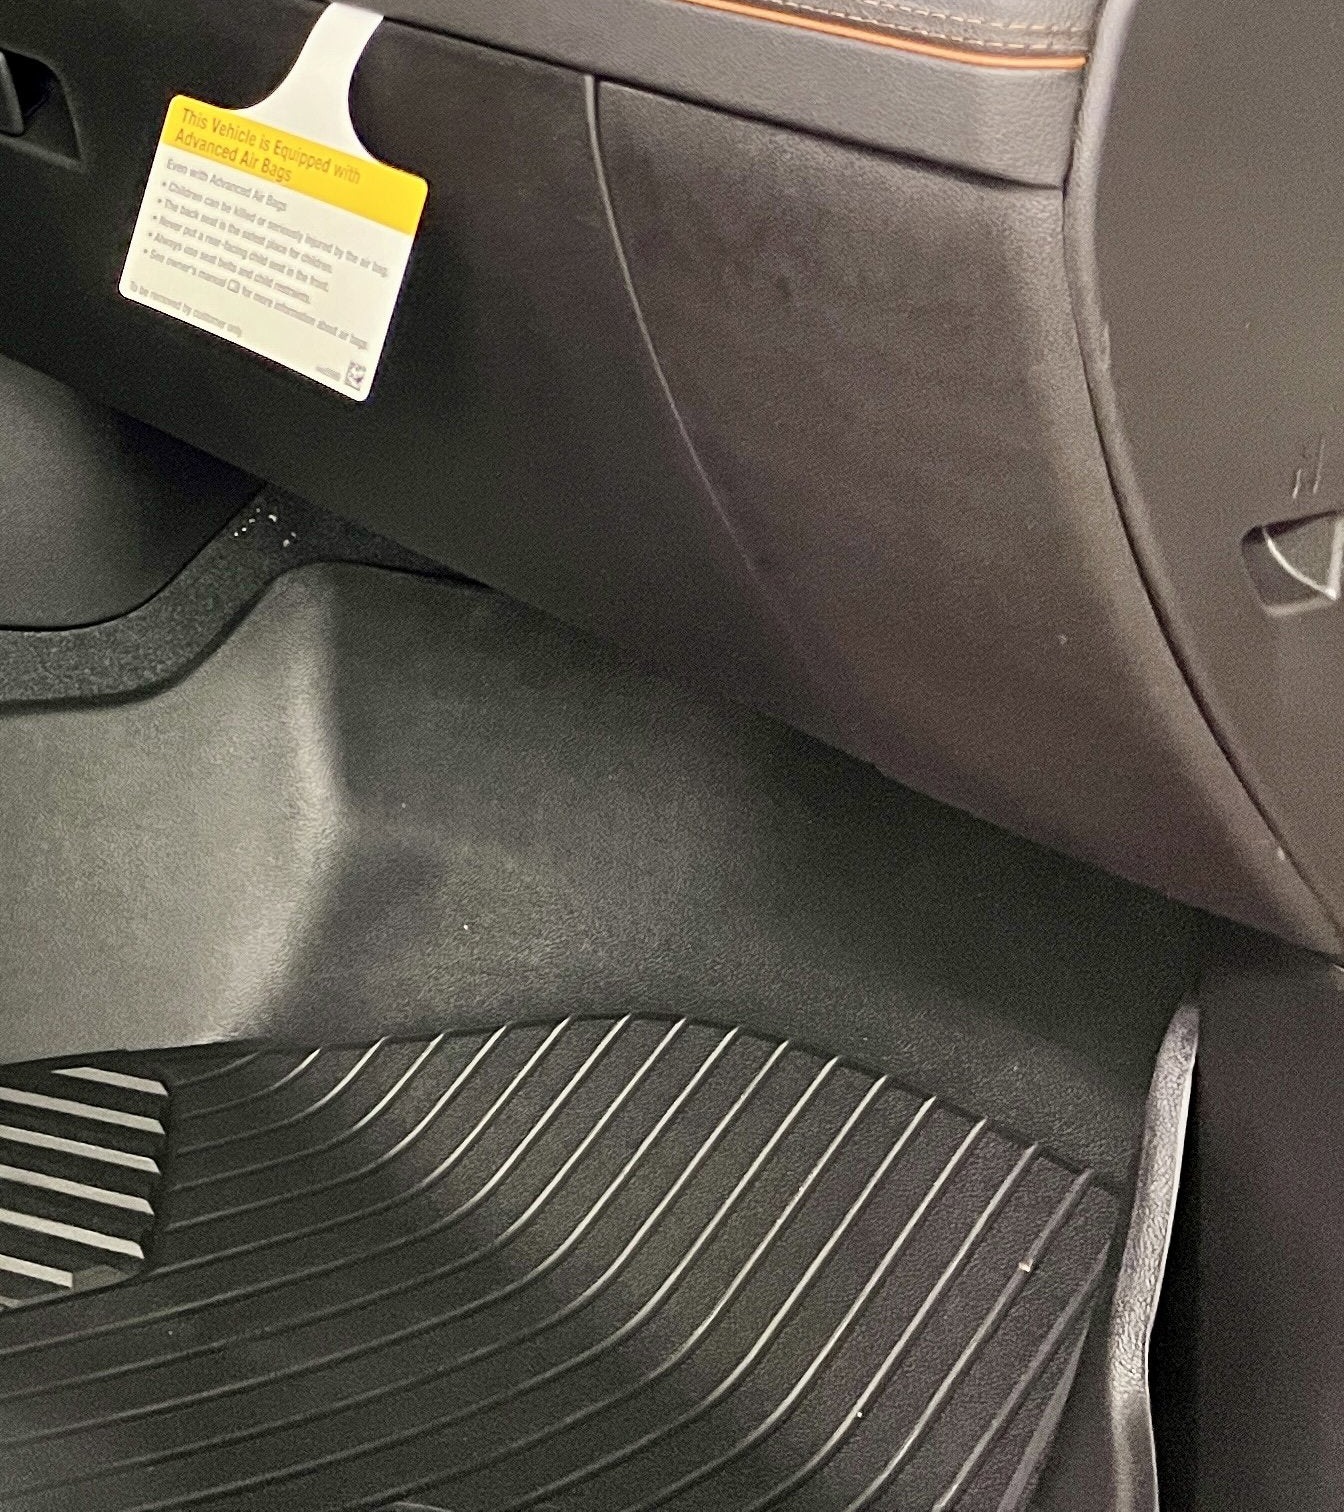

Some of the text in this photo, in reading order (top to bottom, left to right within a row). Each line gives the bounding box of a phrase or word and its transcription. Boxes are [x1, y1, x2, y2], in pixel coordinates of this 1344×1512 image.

[175, 129, 292, 186] Advanced Air Bags
[181, 108, 361, 184] This Vehicle is Equipped with
